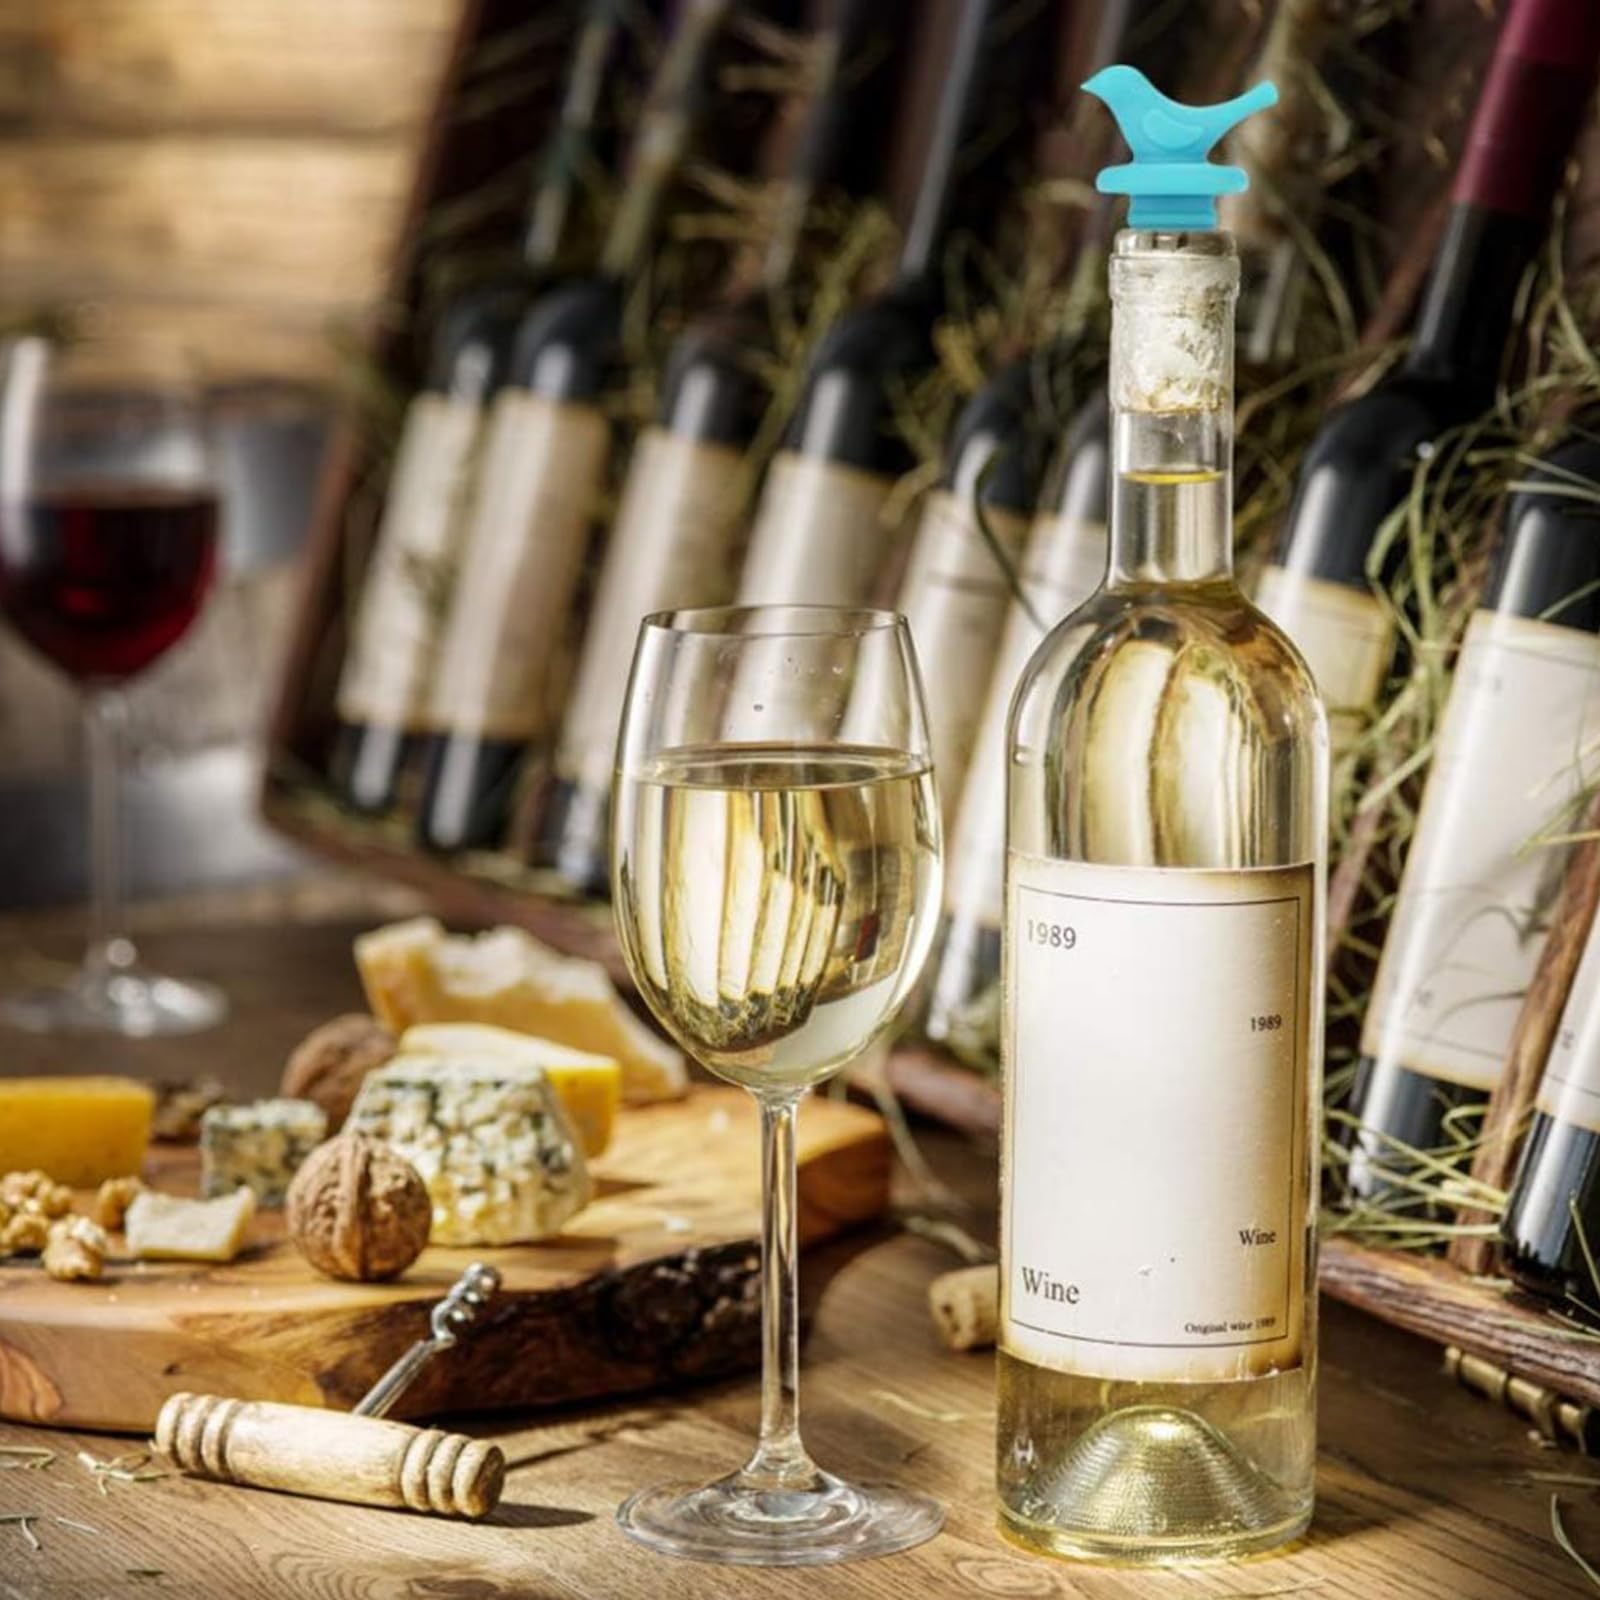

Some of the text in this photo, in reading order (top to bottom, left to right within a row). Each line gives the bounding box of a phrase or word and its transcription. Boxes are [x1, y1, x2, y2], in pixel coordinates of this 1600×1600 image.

[1027, 918, 1077, 950] 1989
[1250, 1013, 1282, 1033] 1989
[1238, 1228, 1277, 1246] Wine
[1021, 1266, 1080, 1305] Wine
[1184, 1321, 1227, 1336] Original
